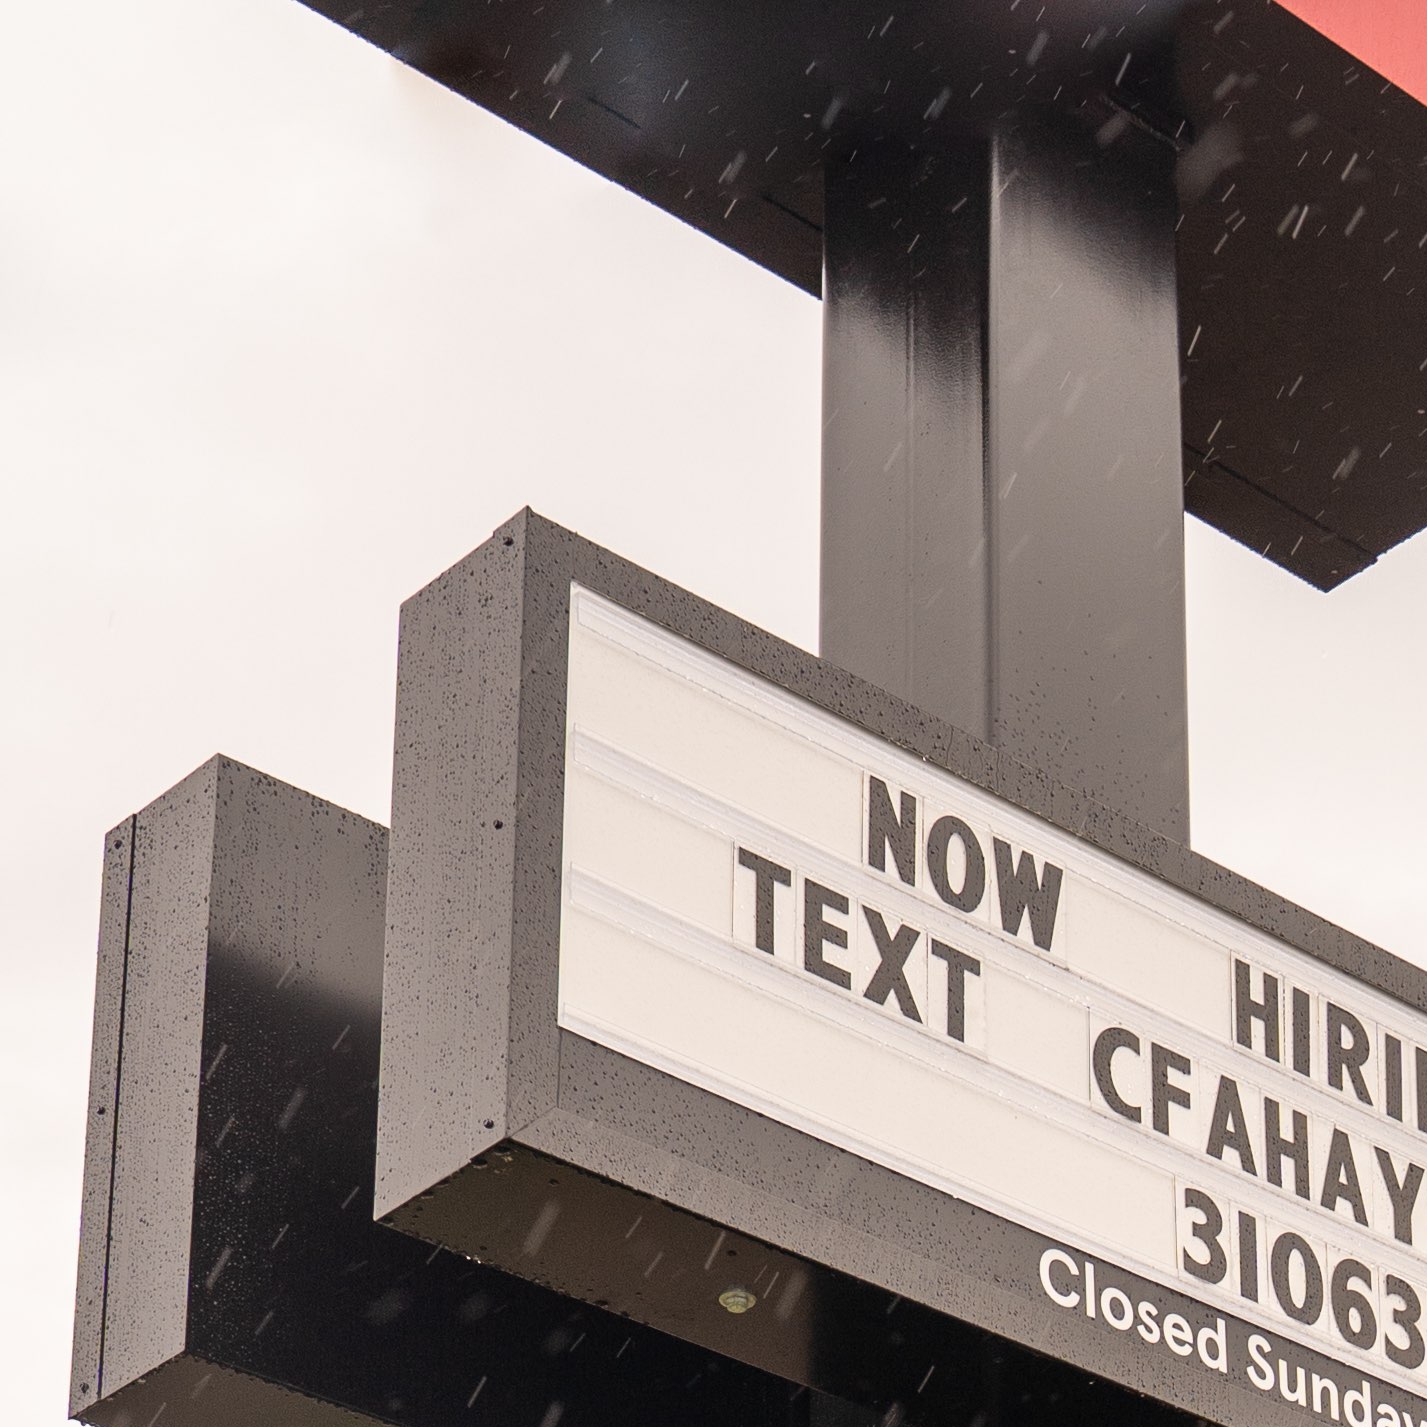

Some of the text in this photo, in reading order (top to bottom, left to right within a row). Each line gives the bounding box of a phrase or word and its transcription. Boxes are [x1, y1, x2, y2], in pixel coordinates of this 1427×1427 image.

[738, 844, 981, 1045] TEXT
[866, 774, 1064, 953] NOW
[1037, 1246, 1229, 1377] Closed
[1181, 1187, 1427, 1371] 31063
